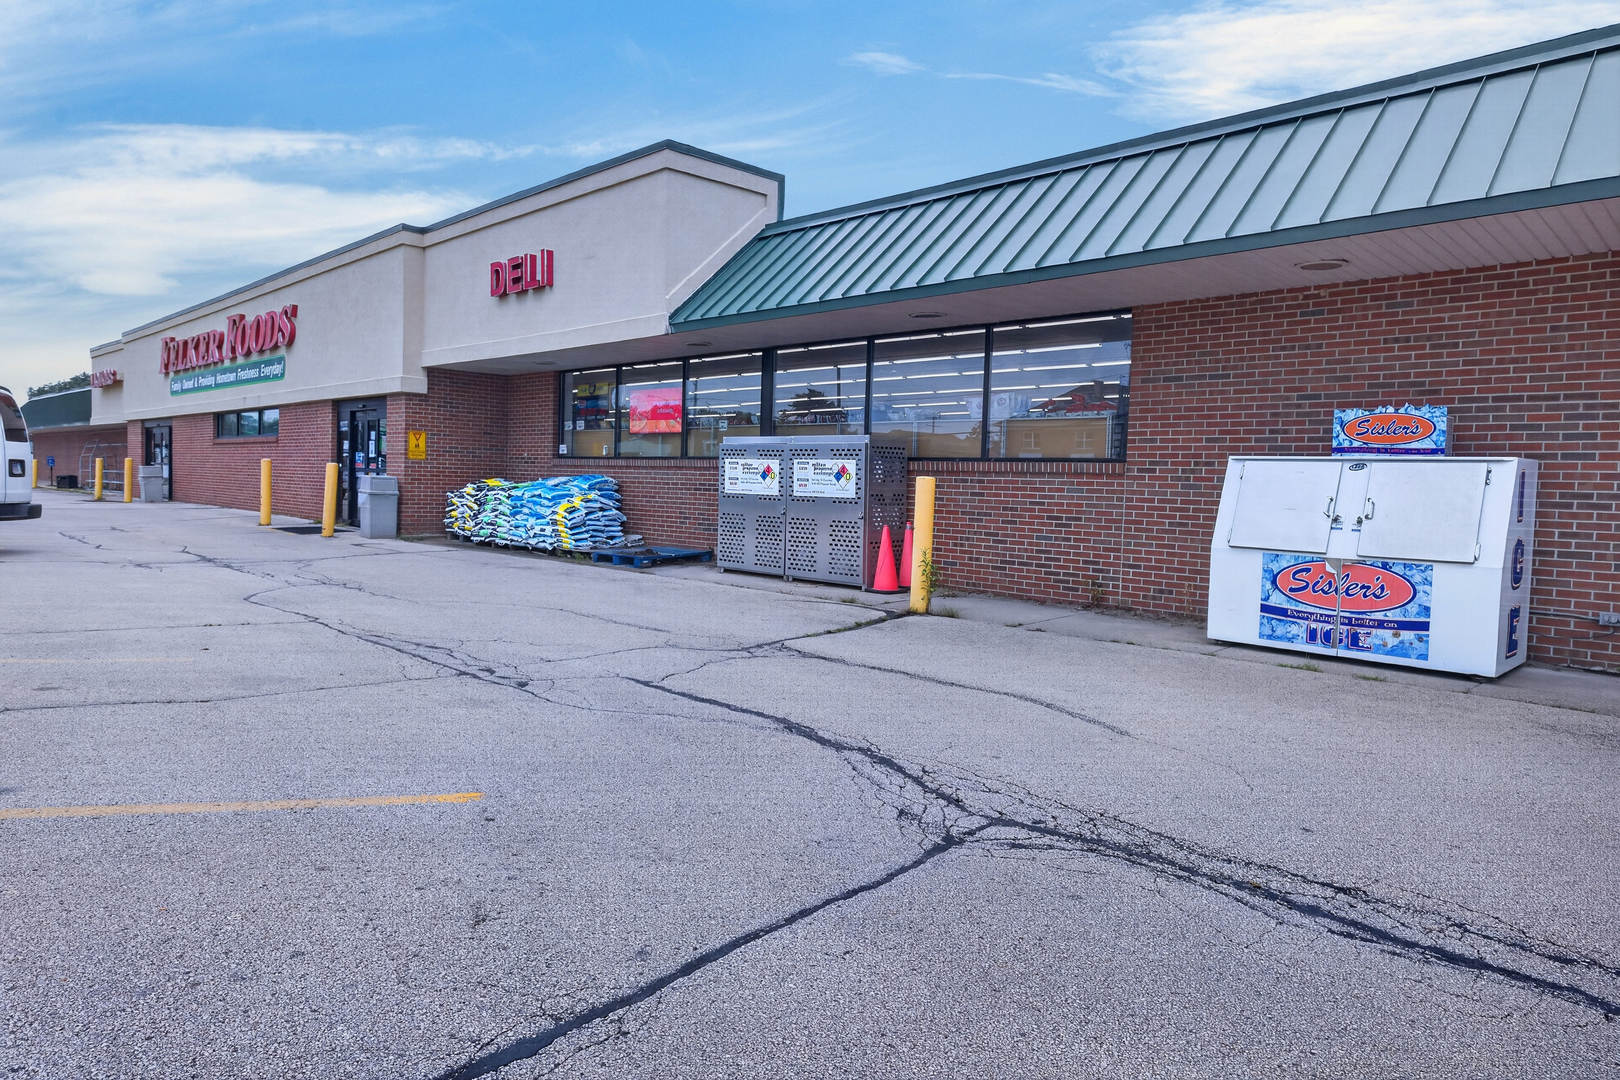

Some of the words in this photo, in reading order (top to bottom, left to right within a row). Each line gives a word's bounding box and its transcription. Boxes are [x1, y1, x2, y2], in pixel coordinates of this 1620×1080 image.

[490, 248, 553, 297] DELI
[159, 330, 224, 374] FELKER
[171, 381, 181, 392] Family
[182, 379, 194, 390] Owned
[199, 374, 215, 387] Providing
[216, 371, 237, 384] Hometown
[237, 367, 259, 380] Freshness
[260, 360, 284, 378] Everyday!
[1354, 417, 1422, 437] Sisler's
[845, 472, 851, 481] 0
[1288, 566, 1390, 600] Sisler's
[1287, 609, 1337, 625] Everything
[1340, 616, 1349, 624] is
[1352, 617, 1379, 626] better
[1306, 621, 1374, 651] ICE
